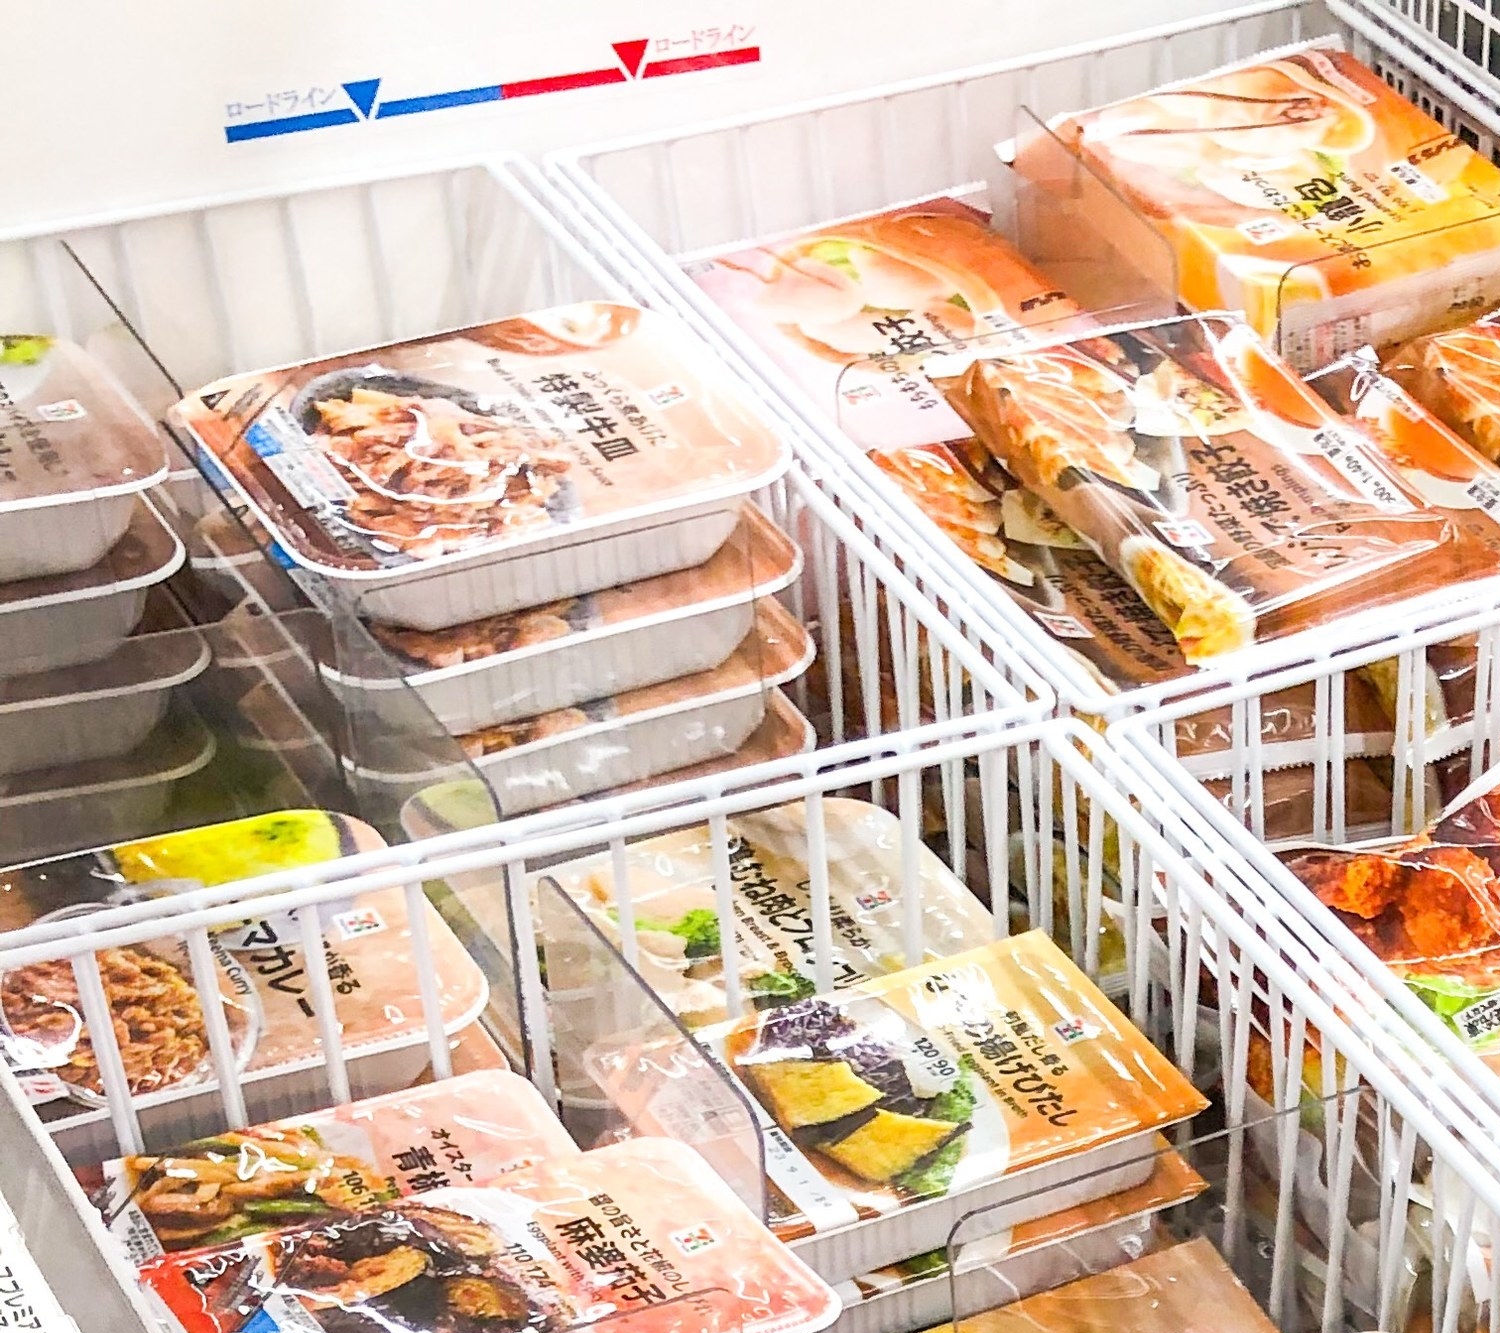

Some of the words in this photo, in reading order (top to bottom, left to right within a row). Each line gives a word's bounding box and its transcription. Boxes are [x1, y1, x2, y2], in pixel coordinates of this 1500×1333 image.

[226, 86, 337, 118] ロードライン
[531, 372, 640, 462] 特製牛皿
[913, 1036, 939, 1059] 120
[934, 1053, 957, 1076] 90
[506, 1242, 533, 1264] 110
[525, 1220, 564, 1263] Eggplant
[555, 1216, 667, 1306] 麻婆茄子
